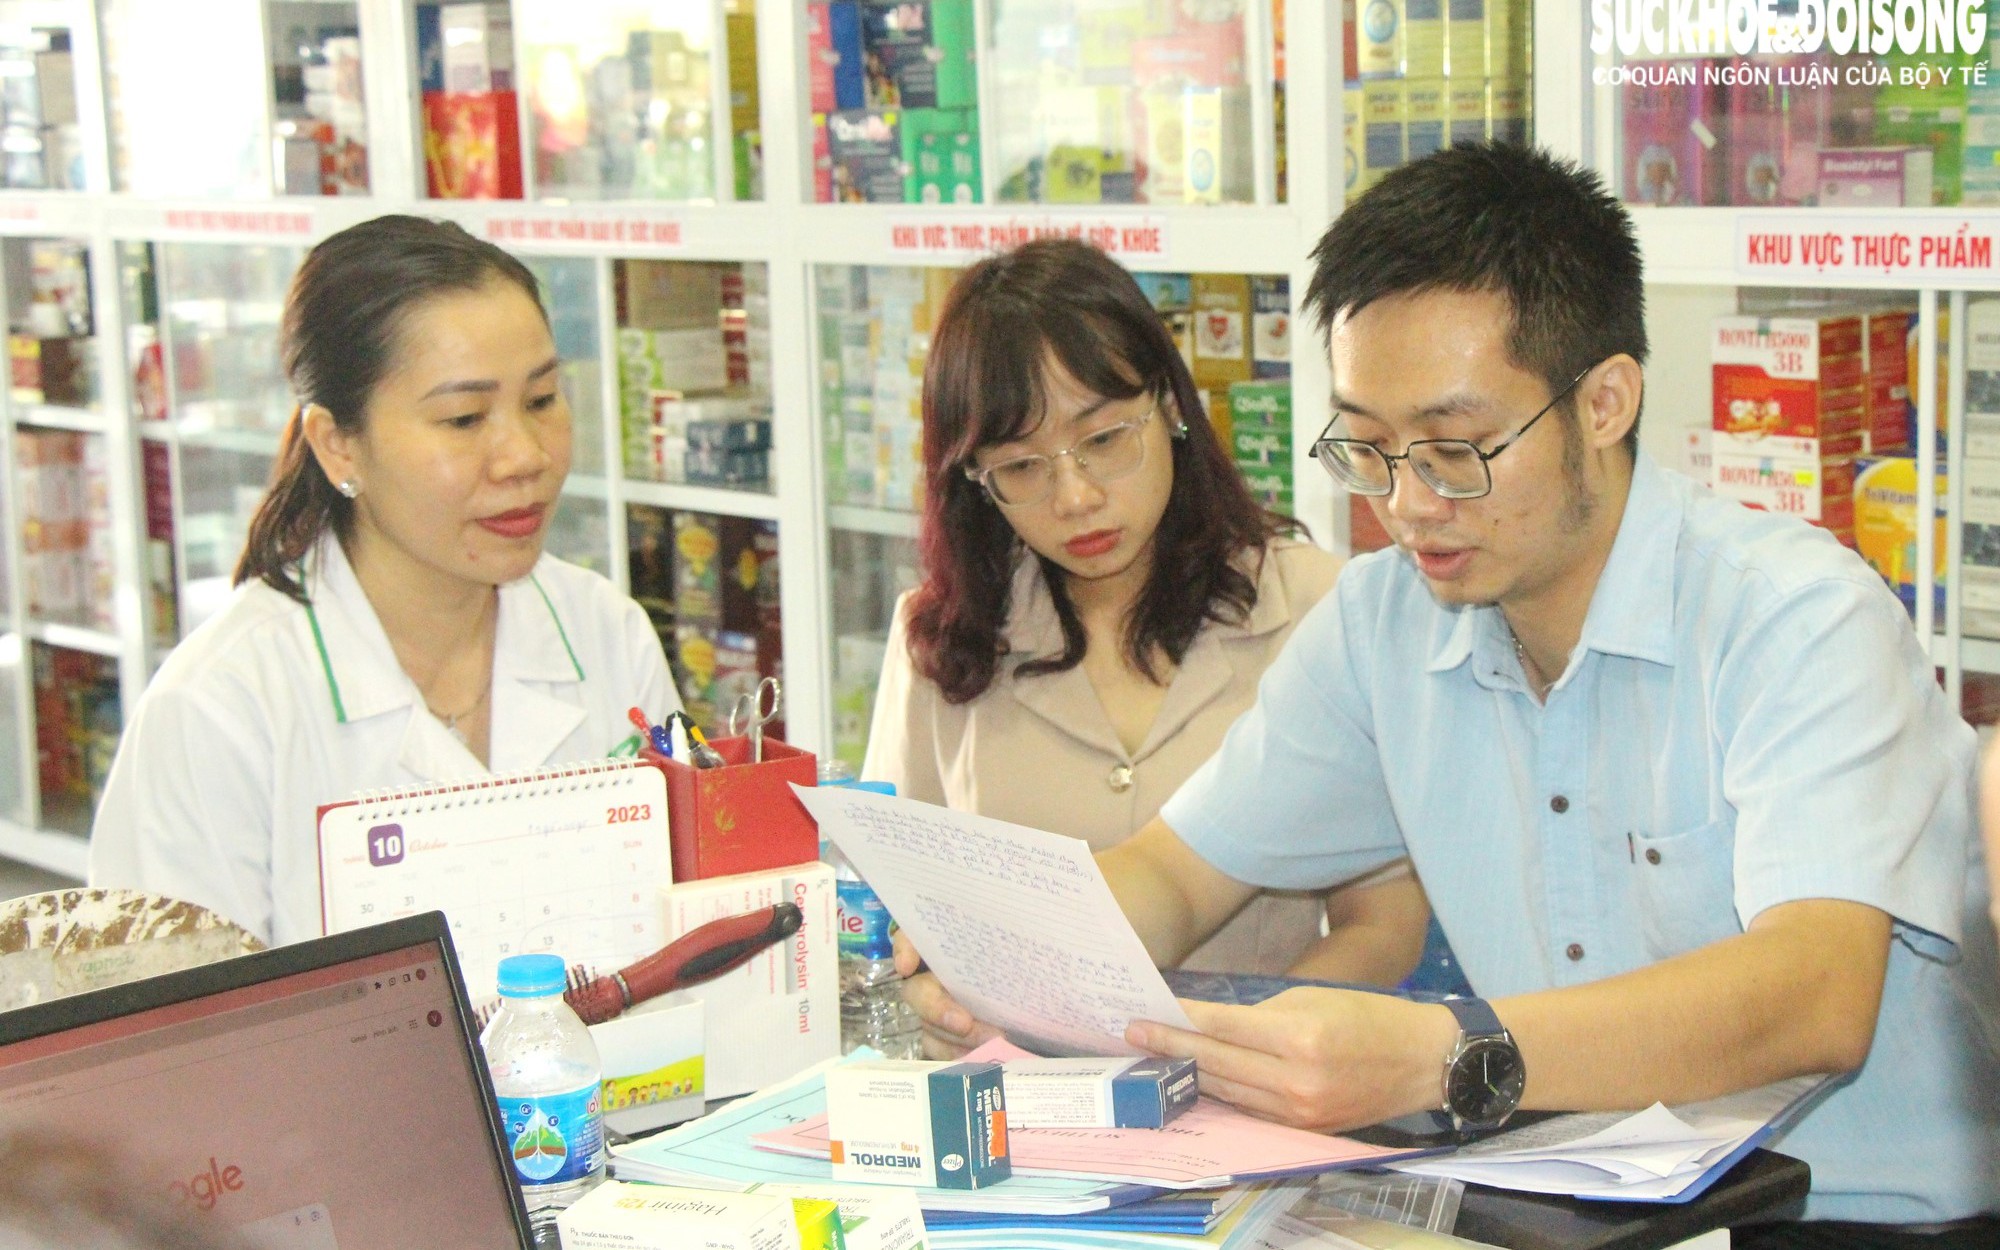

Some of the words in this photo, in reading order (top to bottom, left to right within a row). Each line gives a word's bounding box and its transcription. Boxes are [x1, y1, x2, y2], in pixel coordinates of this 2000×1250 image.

[1749, 234, 1792, 265] KHU
[1801, 232, 1844, 272] VỰC
[1852, 232, 1911, 274] THỰC
[1920, 222, 1991, 268] PHẨM
[606, 804, 651, 824] 2023
[374, 835, 401, 858] 10
[361, 903, 374, 914] 30
[404, 896, 414, 906] 31
[499, 912, 506, 922] 5
[543, 905, 550, 915] 6
[499, 943, 509, 953] 12
[543, 936, 554, 946] 13
[799, 998, 810, 1033] 10ml
[977, 1100, 982, 1112] mg
[901, 1142, 913, 1152] mg
[851, 1153, 921, 1169] MEDROL
[942, 1155, 963, 1170] Pfizer
[614, 1199, 648, 1210] 125
[649, 1201, 728, 1216] Haginir
